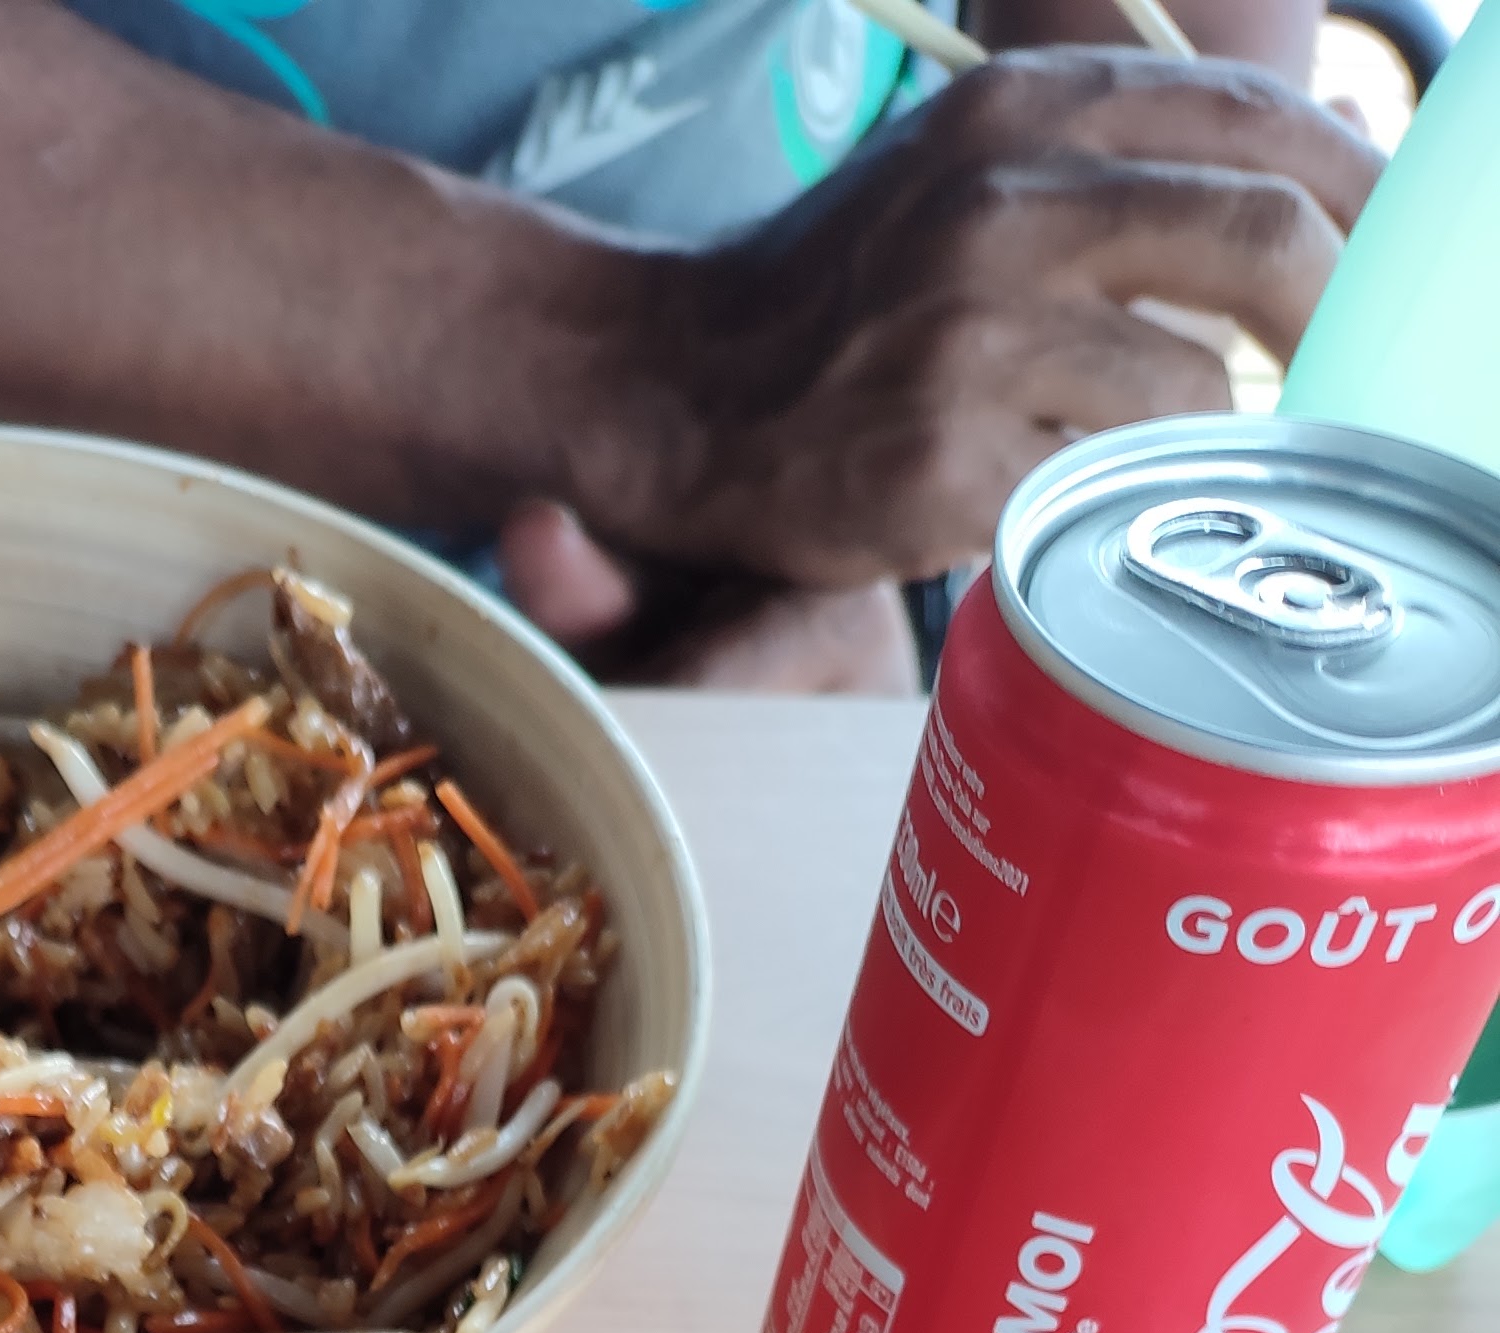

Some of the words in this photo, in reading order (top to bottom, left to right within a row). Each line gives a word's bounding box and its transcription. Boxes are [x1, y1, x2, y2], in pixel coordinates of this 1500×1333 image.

[1165, 893, 1438, 969] GOÛT
[908, 943, 935, 990] très
[939, 980, 982, 1029] frais
